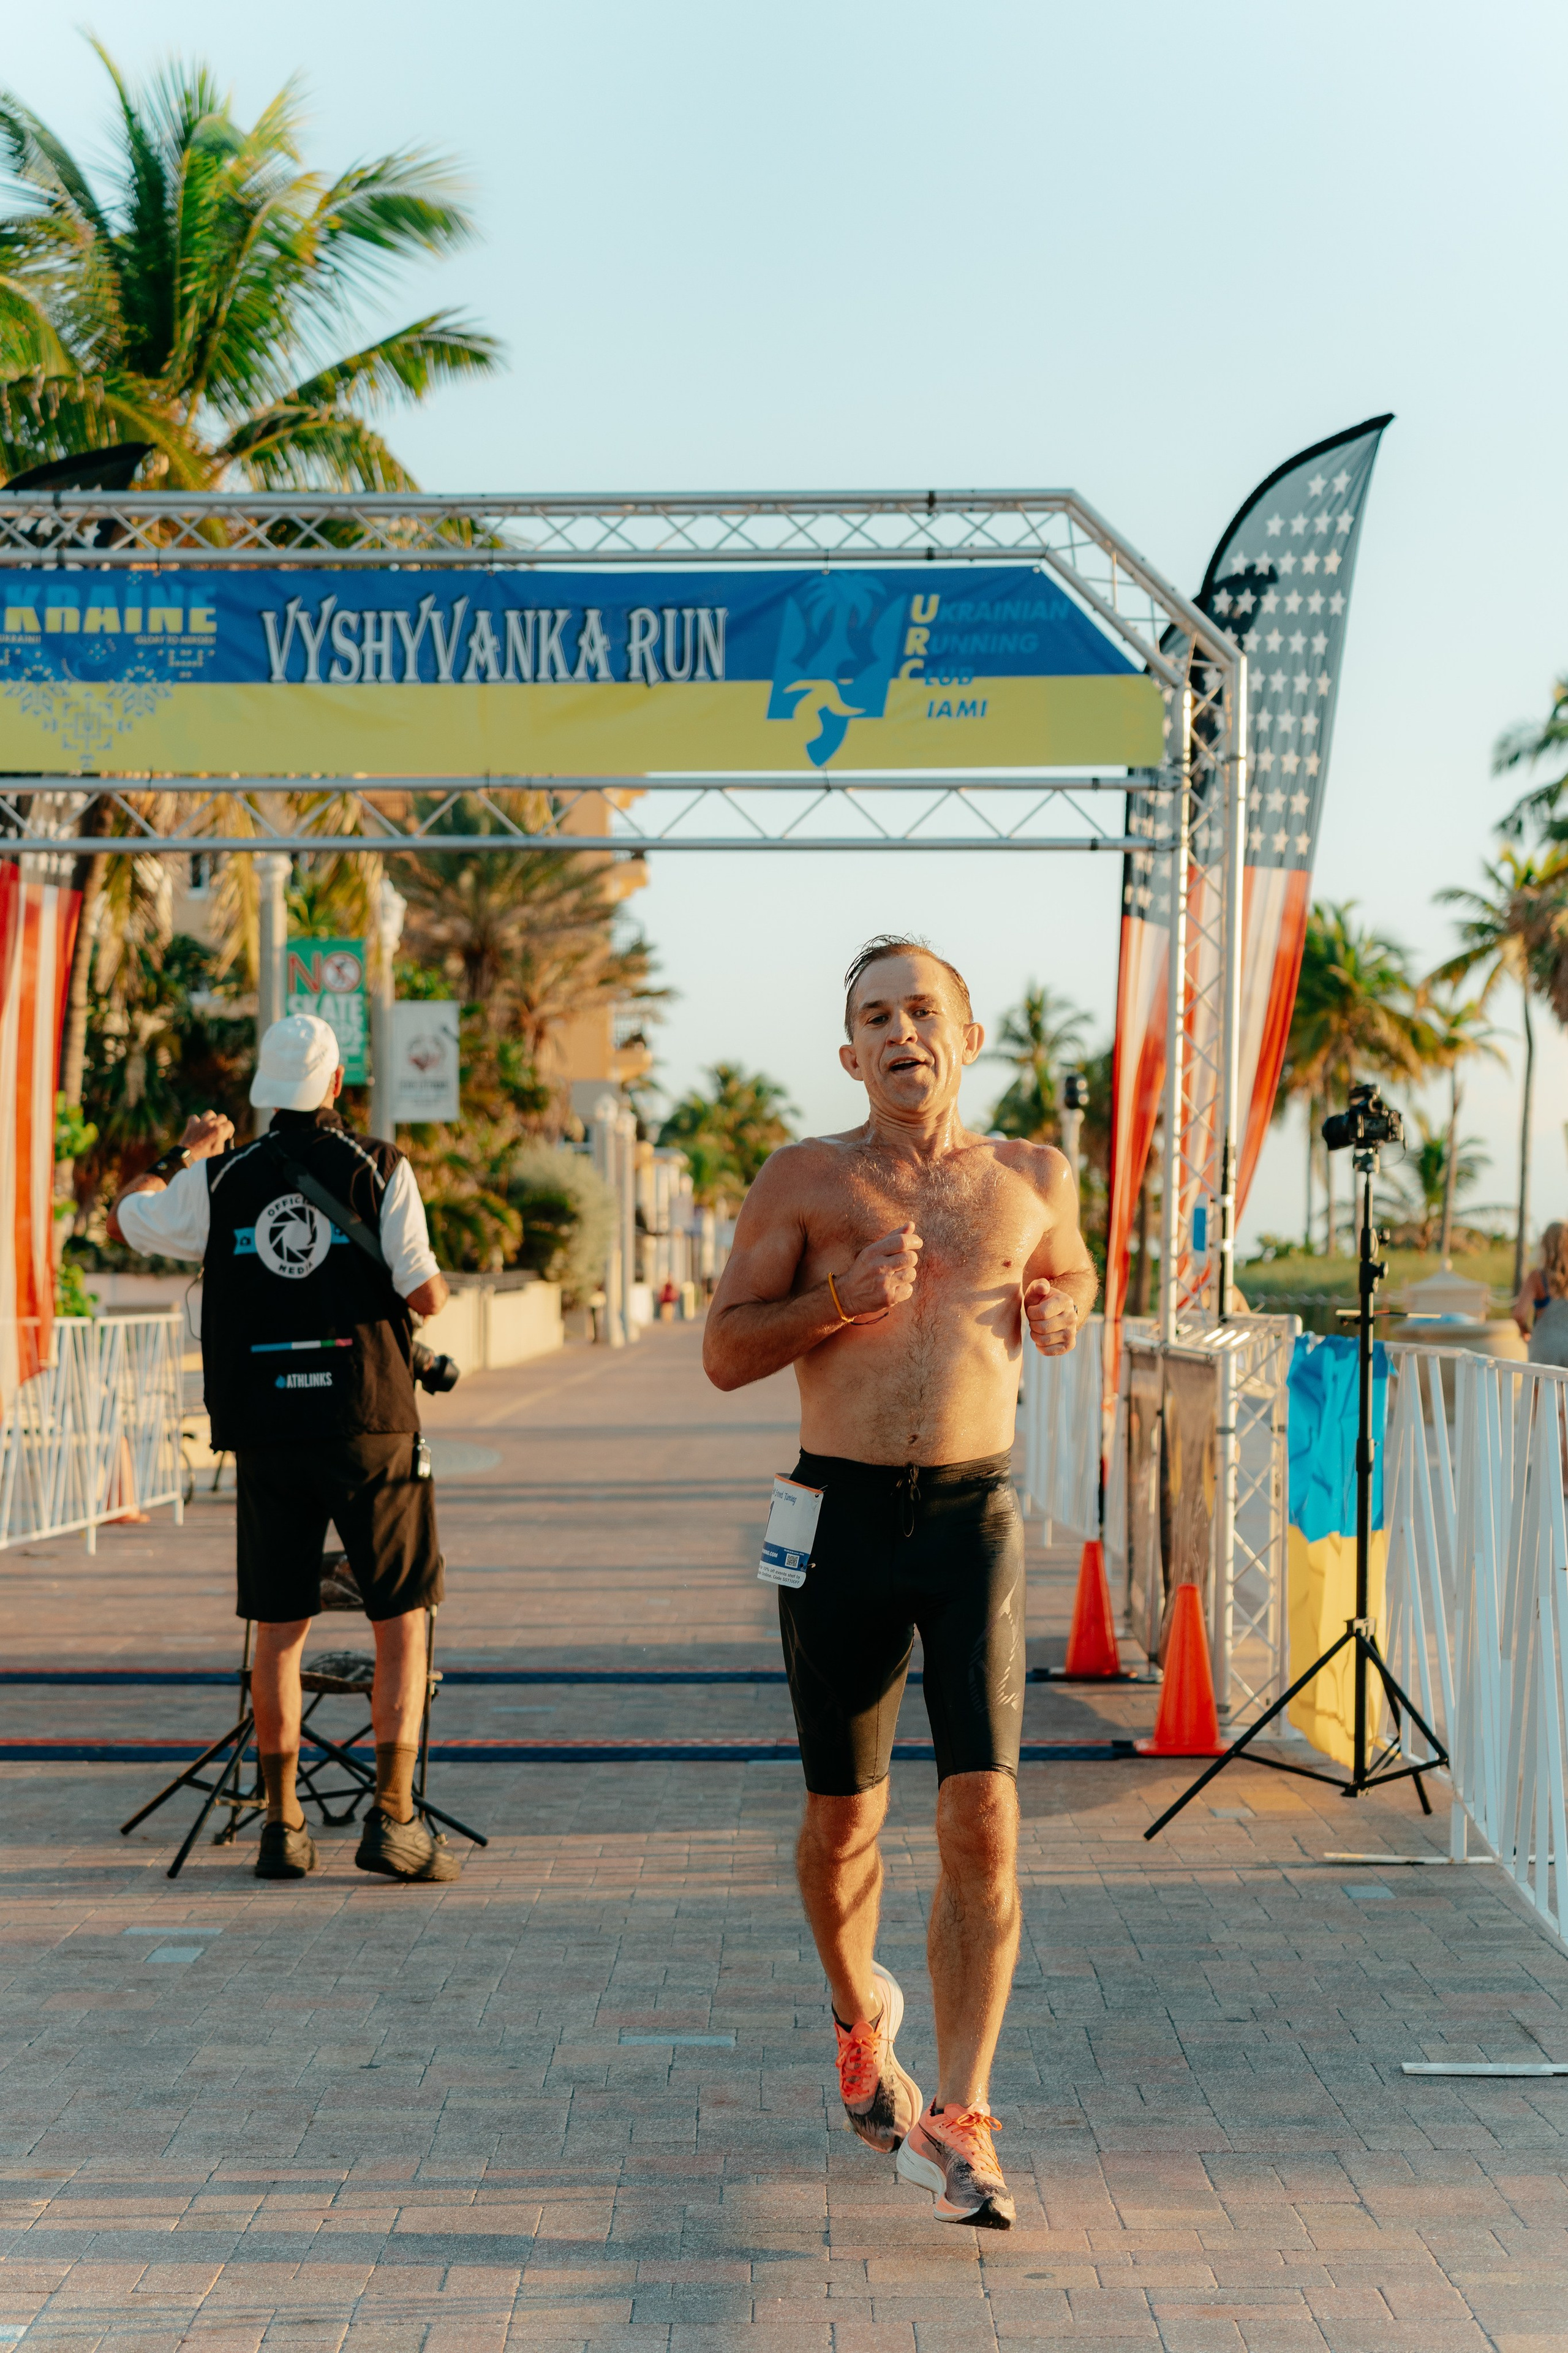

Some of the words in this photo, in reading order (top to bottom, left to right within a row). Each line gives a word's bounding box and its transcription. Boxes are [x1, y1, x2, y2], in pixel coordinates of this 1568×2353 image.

[911, 594, 1071, 624] UKRAINIAN
[260, 594, 615, 685] VYSHYVANKA
[627, 606, 729, 687] RUN
[903, 626, 1039, 655] RUNNING
[288, 994, 363, 1021] SKATE
[279, 1260, 314, 1275] MEDIA
[286, 1372, 333, 1388] ATHLINKS
